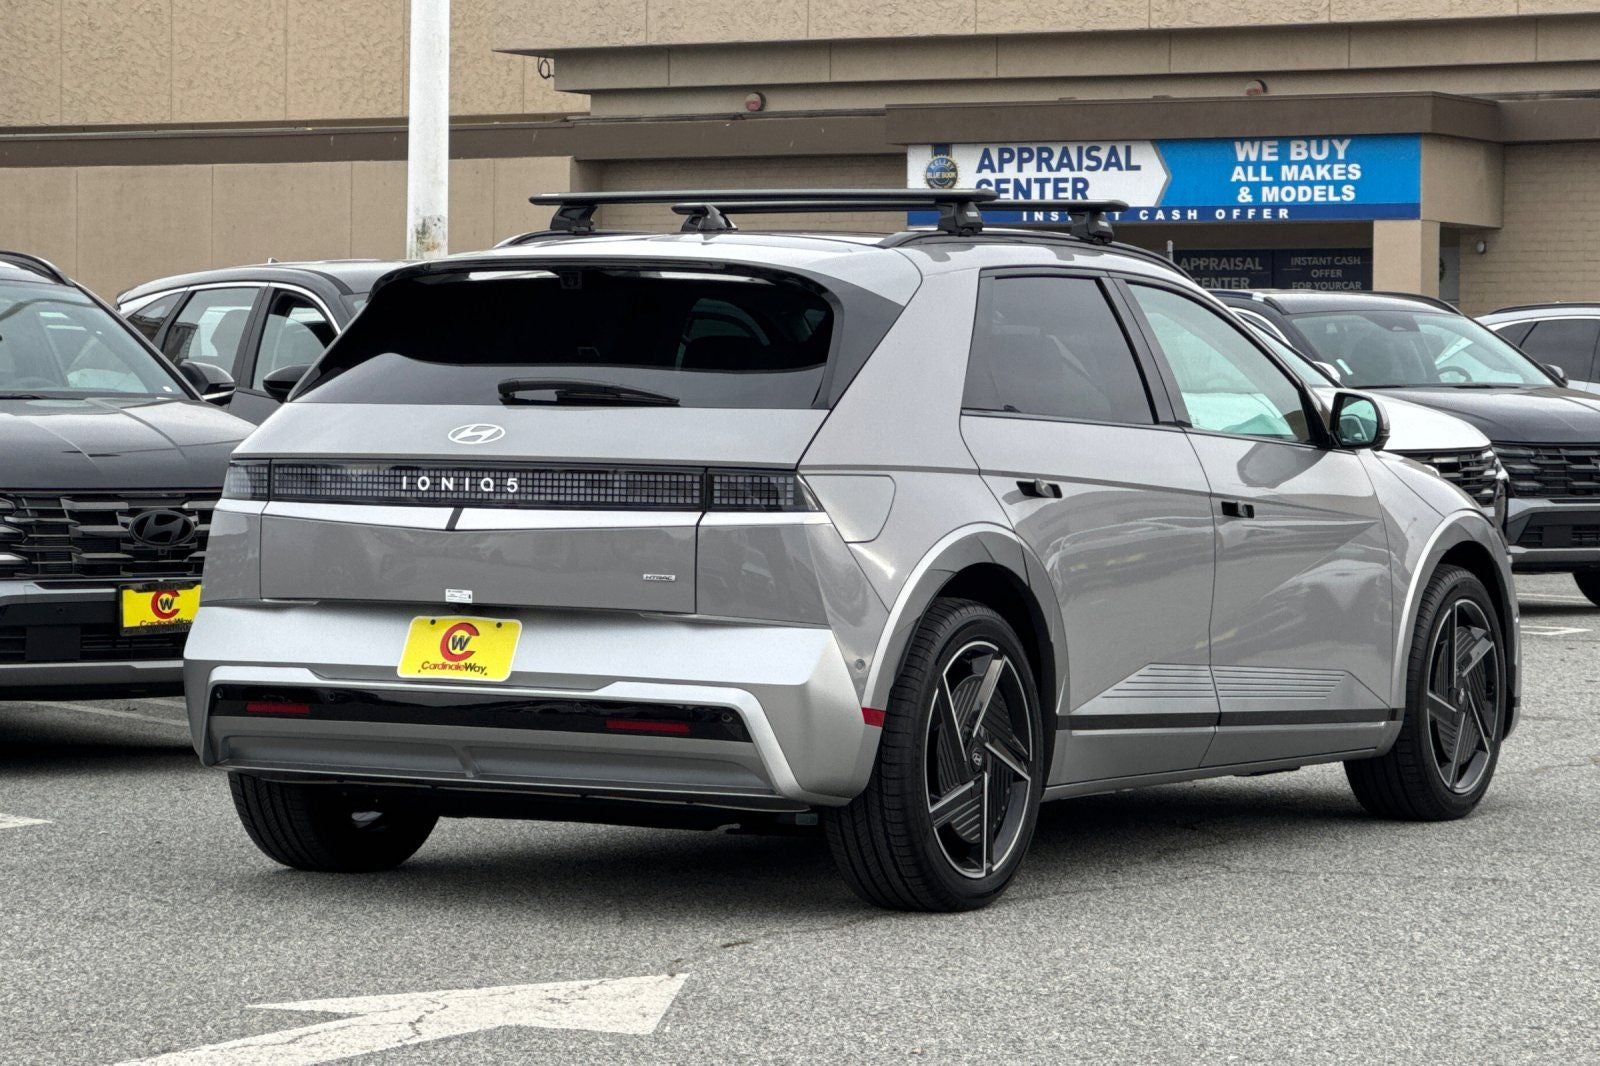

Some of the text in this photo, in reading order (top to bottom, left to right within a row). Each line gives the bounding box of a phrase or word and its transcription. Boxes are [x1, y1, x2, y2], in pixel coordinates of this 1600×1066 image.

[1235, 138, 1352, 162] WE BUY
[976, 145, 1141, 173] APPRAISAL
[1230, 163, 1362, 182] ALL MAKES
[1237, 184, 1356, 203] & MODELS
[1022, 208, 1289, 221] INST CASH OFFER
[1180, 257, 1263, 271] APPRAISAL
[1290, 255, 1361, 266] INSTANT CASH
[1311, 269, 1343, 278] OFFER
